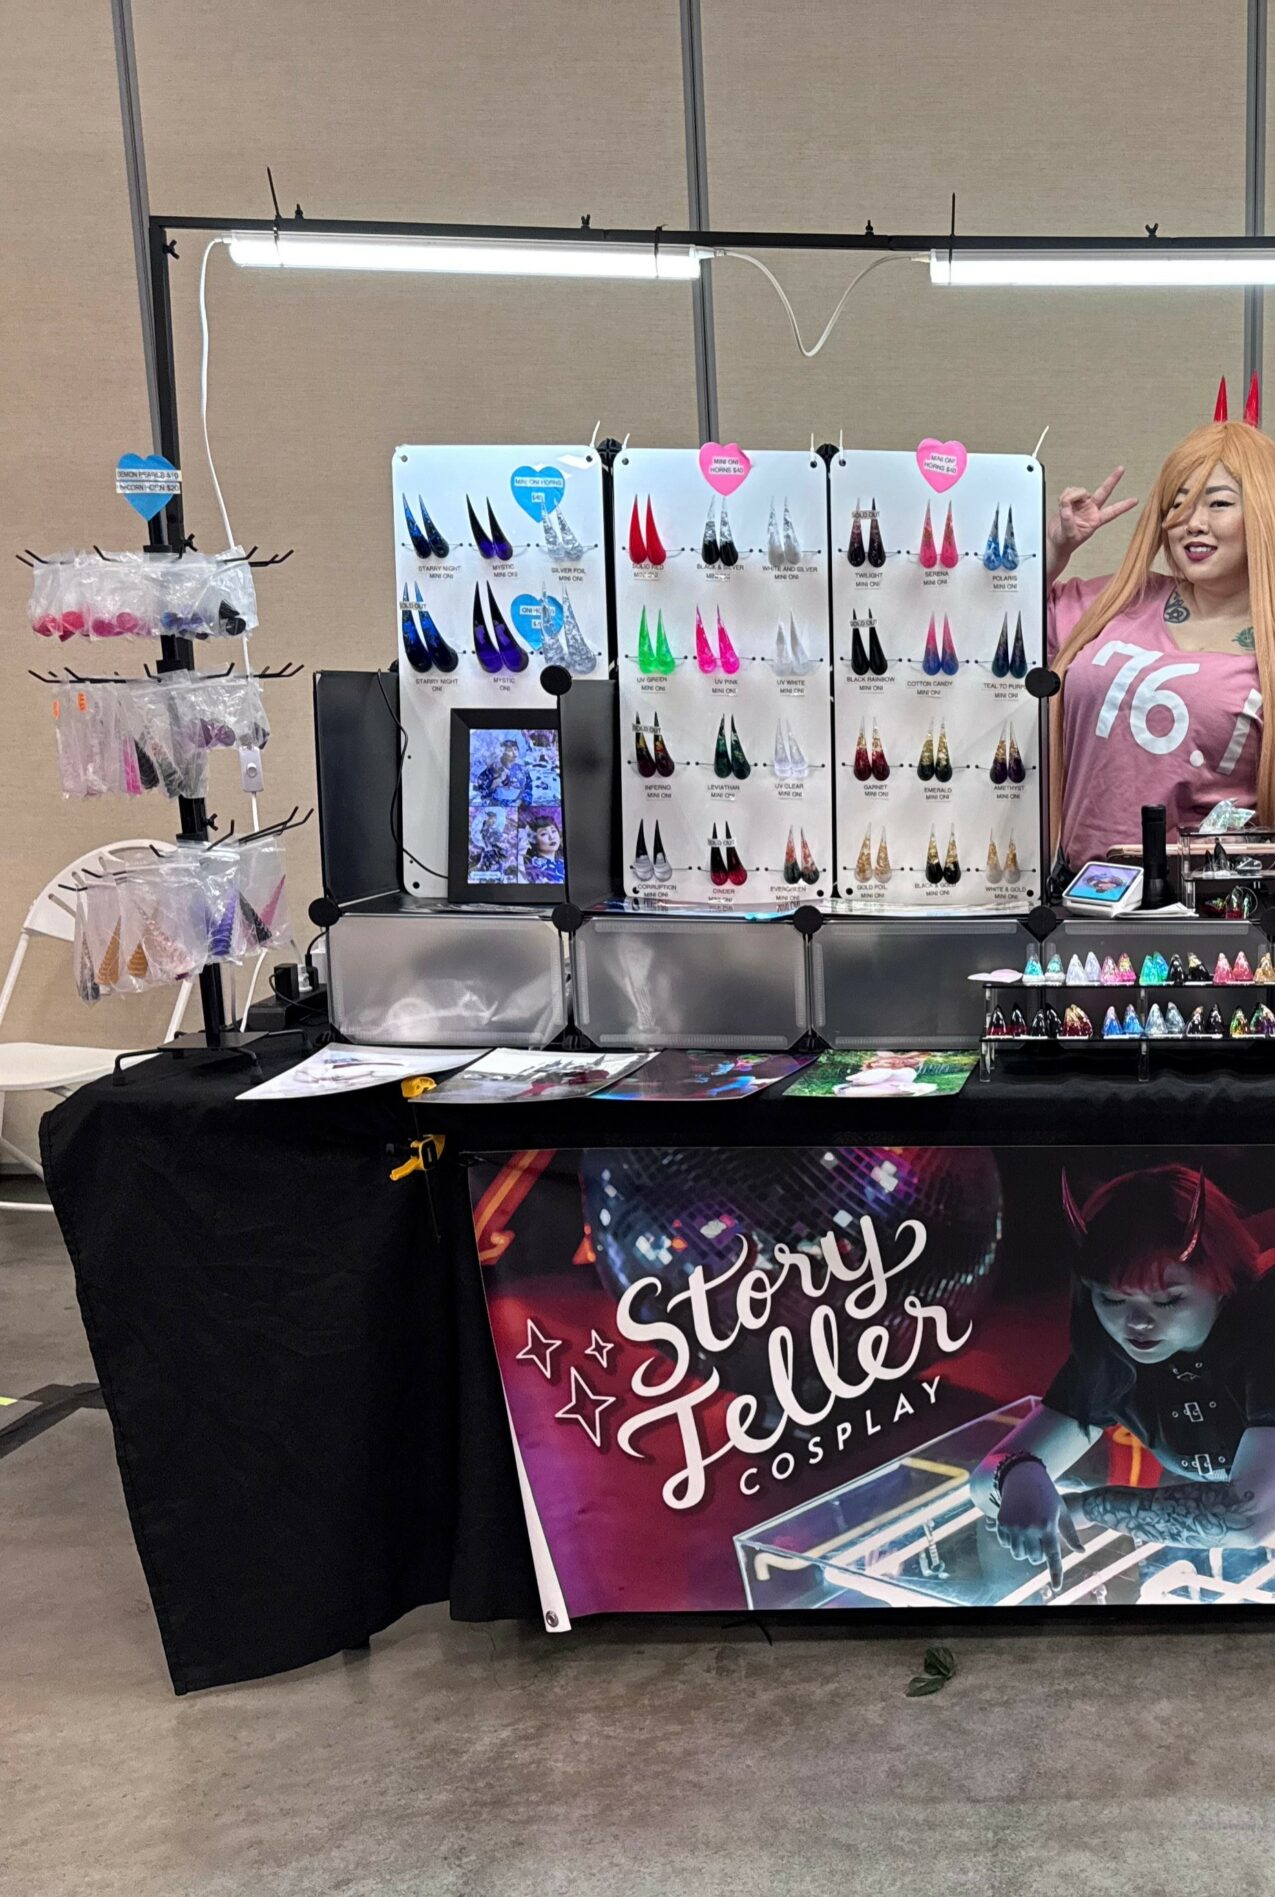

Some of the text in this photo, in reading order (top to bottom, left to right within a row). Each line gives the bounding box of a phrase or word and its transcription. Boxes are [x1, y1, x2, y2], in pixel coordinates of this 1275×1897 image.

[616, 1215, 927, 1397] Story
[617, 1296, 973, 1509] Teller
[739, 1377, 940, 1494] COSPLAY
